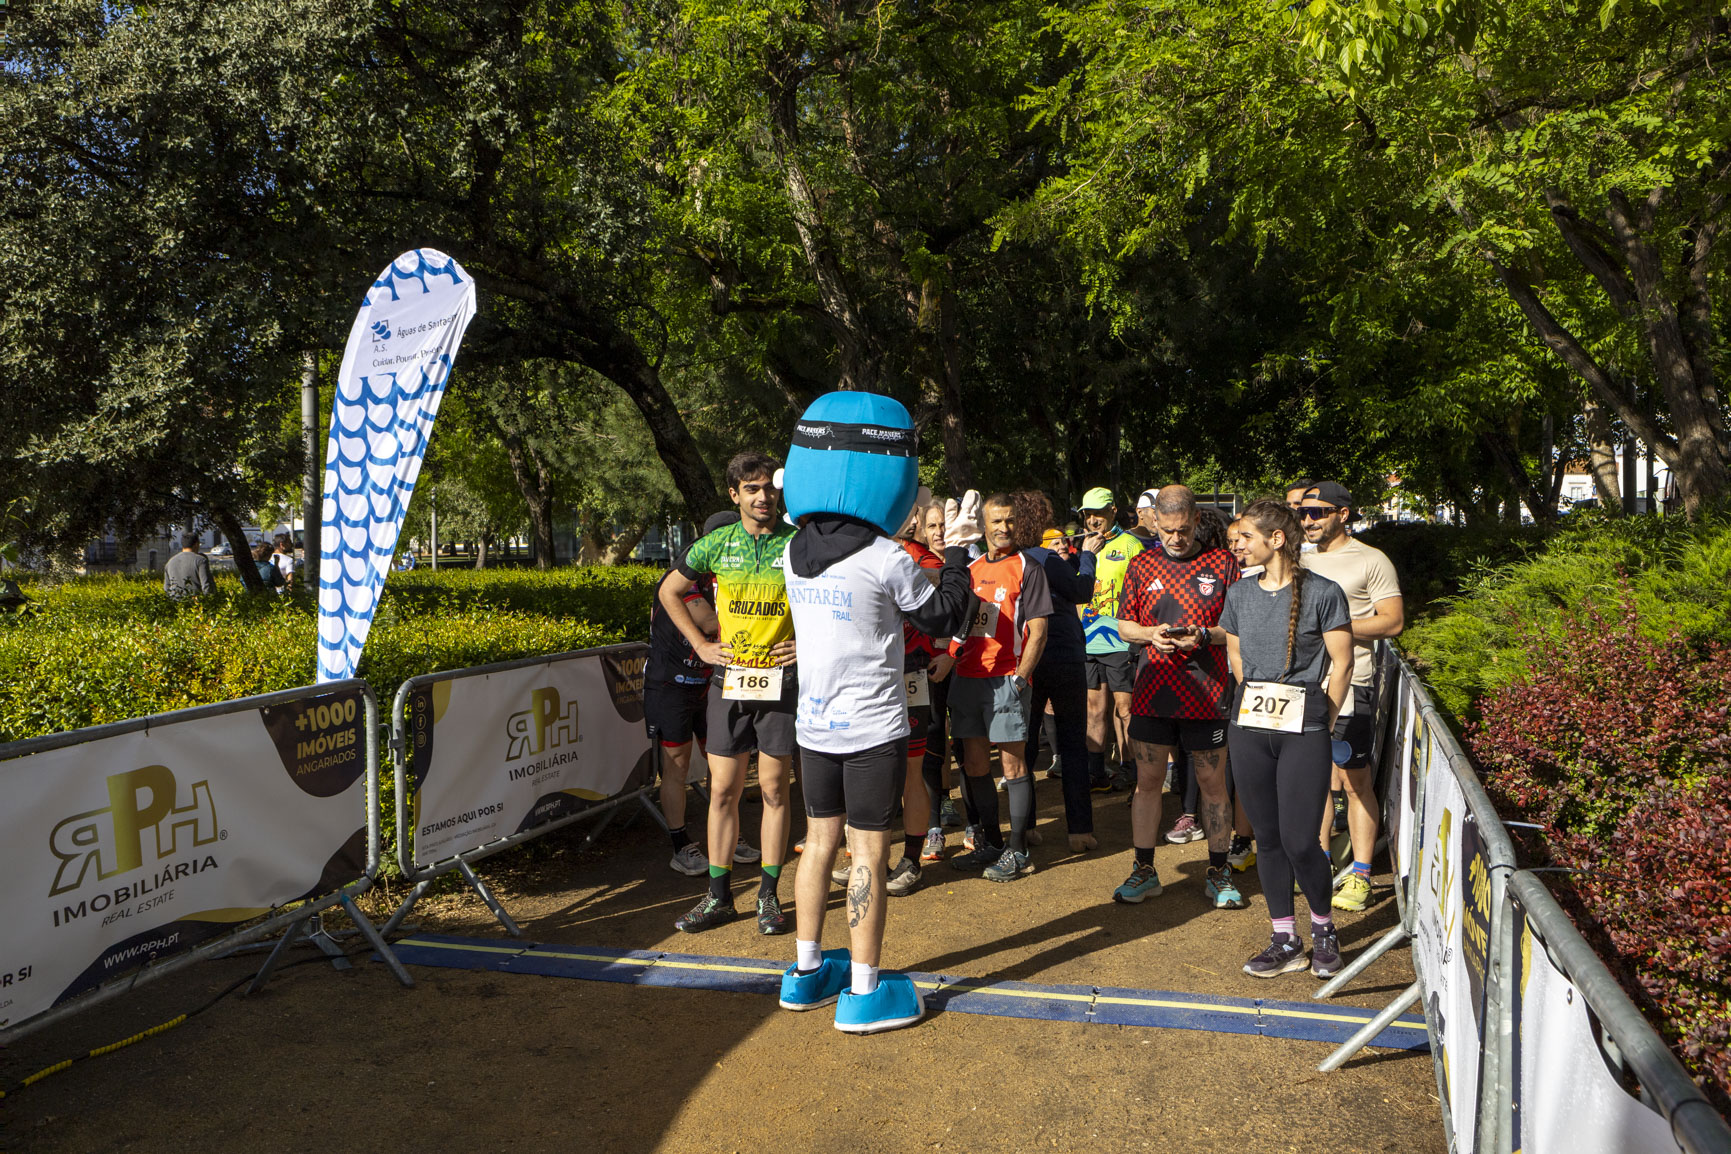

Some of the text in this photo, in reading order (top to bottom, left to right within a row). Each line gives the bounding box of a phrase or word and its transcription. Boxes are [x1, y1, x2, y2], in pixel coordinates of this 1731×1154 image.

[397, 326, 417, 339] Águas
[417, 323, 427, 333] de
[728, 600, 786, 616] CRUZADOS
[832, 610, 852, 621] TRAIL
[737, 675, 769, 688] 186
[295, 699, 356, 732] +1000
[1251, 695, 1290, 715] 207
[297, 728, 356, 759] IMÓVEIS
[296, 748, 356, 776] ANGARIADOS
[509, 751, 579, 781] IMOBILIÁRIA
[422, 802, 504, 836] ESTAMOS AQUI POR SI
[53, 855, 219, 927] IMOBILIÁRIA
[101, 889, 175, 928] REAL ESTATE
[103, 932, 180, 969] WWW.RPH.PT
[0, 965, 32, 988] R SI
